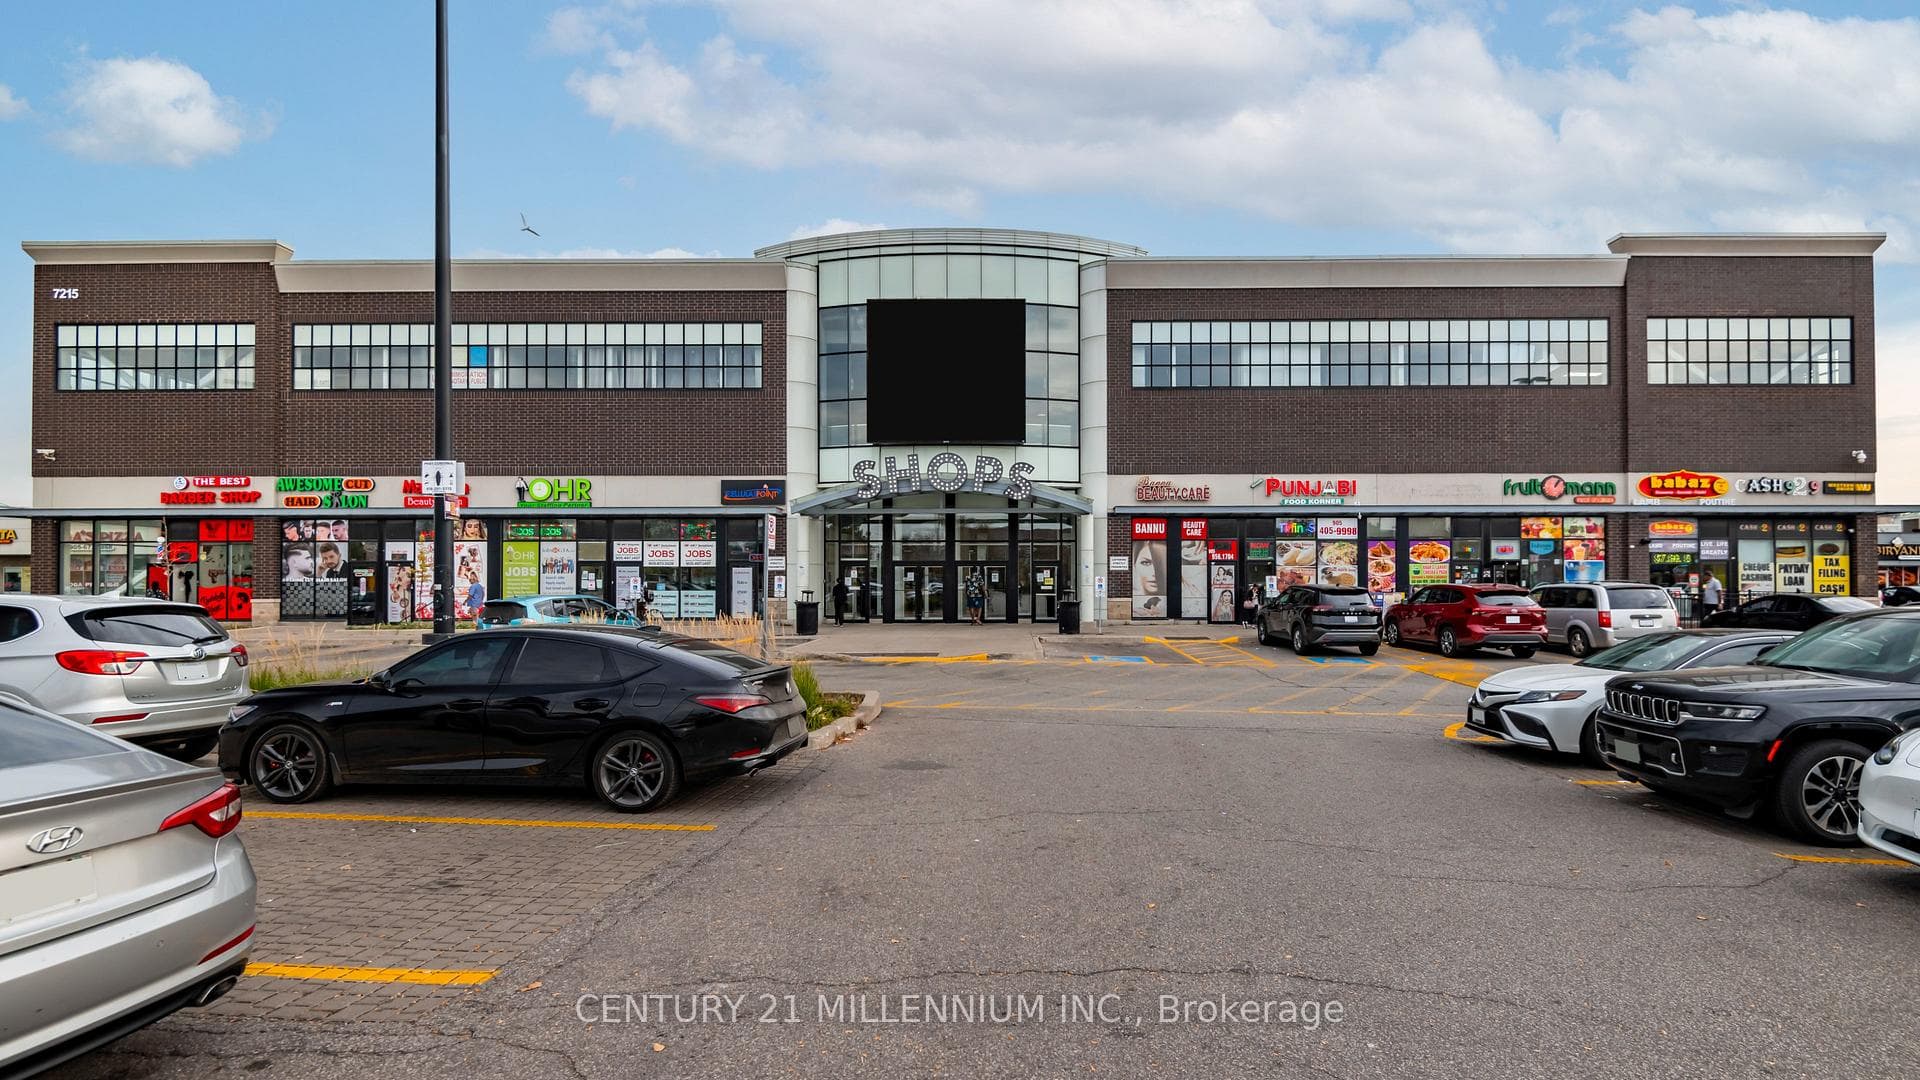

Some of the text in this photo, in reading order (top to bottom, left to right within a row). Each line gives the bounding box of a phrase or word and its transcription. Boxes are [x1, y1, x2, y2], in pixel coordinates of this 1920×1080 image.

[52, 288, 79, 299] 7215
[853, 451, 1036, 500] SHOPS
[194, 477, 247, 486] THE BEST
[276, 477, 371, 492] AWESOME CUT
[1265, 477, 1357, 496] PUNJABI
[1650, 475, 1712, 489] babaz
[1734, 478, 1783, 493] CASH
[528, 477, 592, 501] OHR
[1137, 487, 1210, 500] BEAUTY CARE
[160, 491, 262, 505] BARBER SHOP
[284, 496, 318, 507] HAIR
[1699, 498, 1737, 506] POUTINE
[1135, 522, 1165, 534] BANNU
[1182, 521, 1206, 529] BEAUTY
[1760, 523, 1770, 532] 2
[1798, 523, 1807, 532] 2
[1835, 523, 1844, 532] 2
[1186, 528, 1203, 536] CARE
[647, 550, 675, 558] JOBS
[685, 550, 712, 558] JOBS
[1823, 557, 1841, 567] TAX
[504, 566, 538, 577] JOBS
[1742, 563, 1771, 572] CHEQUE
[1778, 563, 1810, 574] PAYDAY
[1741, 573, 1773, 581] CASHING
[1818, 569, 1846, 578] FILING
[1783, 576, 1806, 586] LOAN
[1819, 584, 1846, 593] CASH
